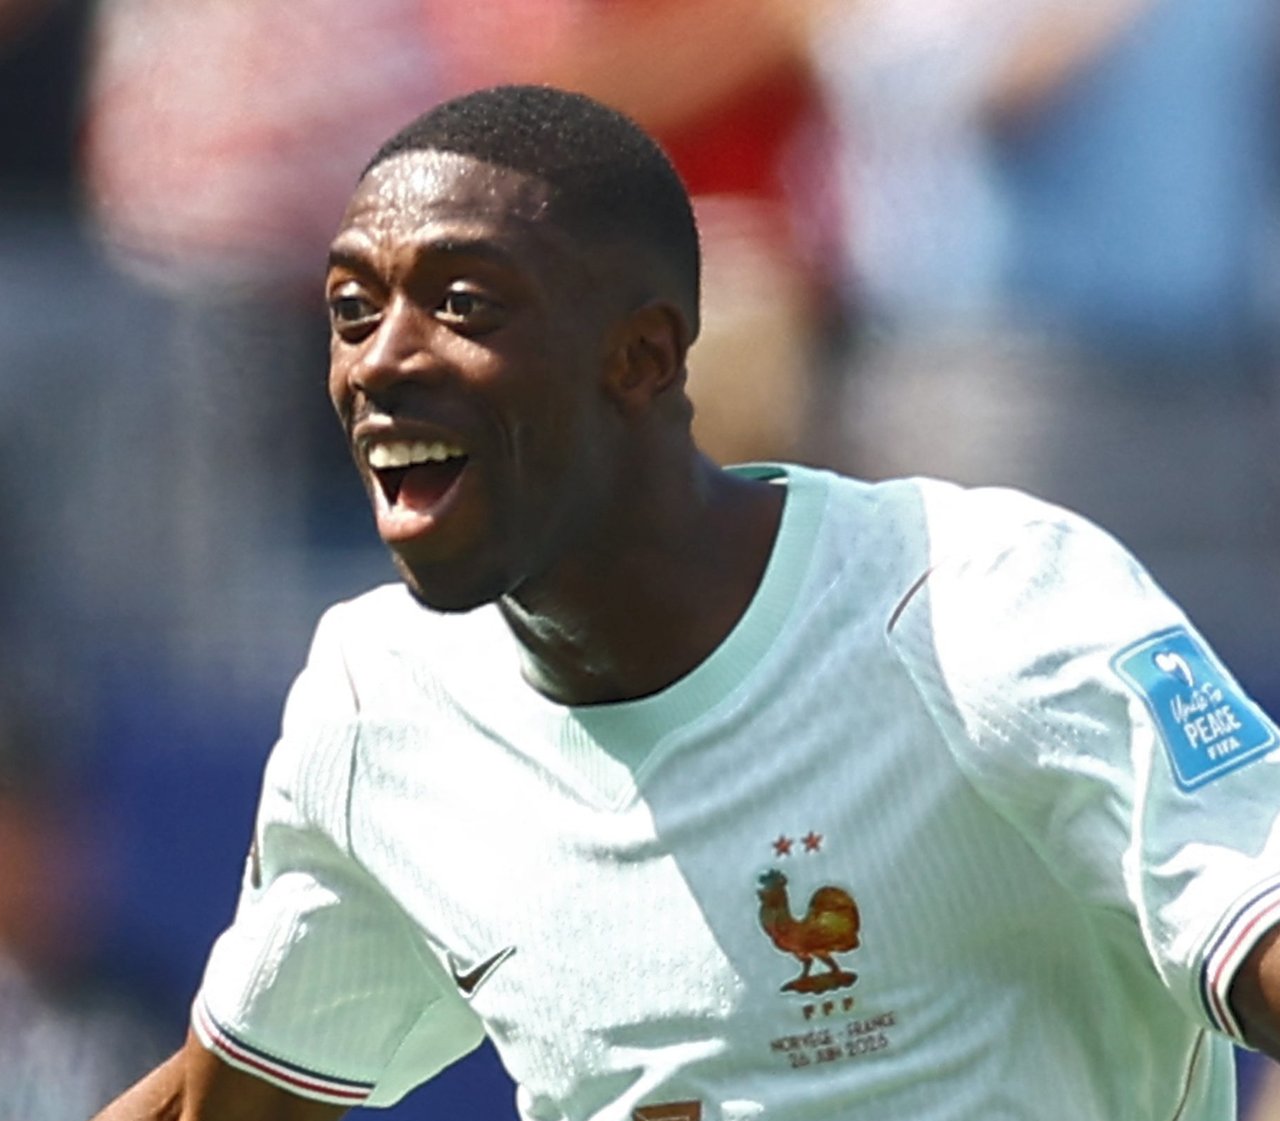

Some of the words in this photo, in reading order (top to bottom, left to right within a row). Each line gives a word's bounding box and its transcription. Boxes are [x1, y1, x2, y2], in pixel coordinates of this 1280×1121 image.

[1184, 705, 1242, 749] PEACE
[1207, 736, 1241, 760] FIFA
[846, 1011, 896, 1036] FRANCE
[846, 1033, 888, 1056] 2026
